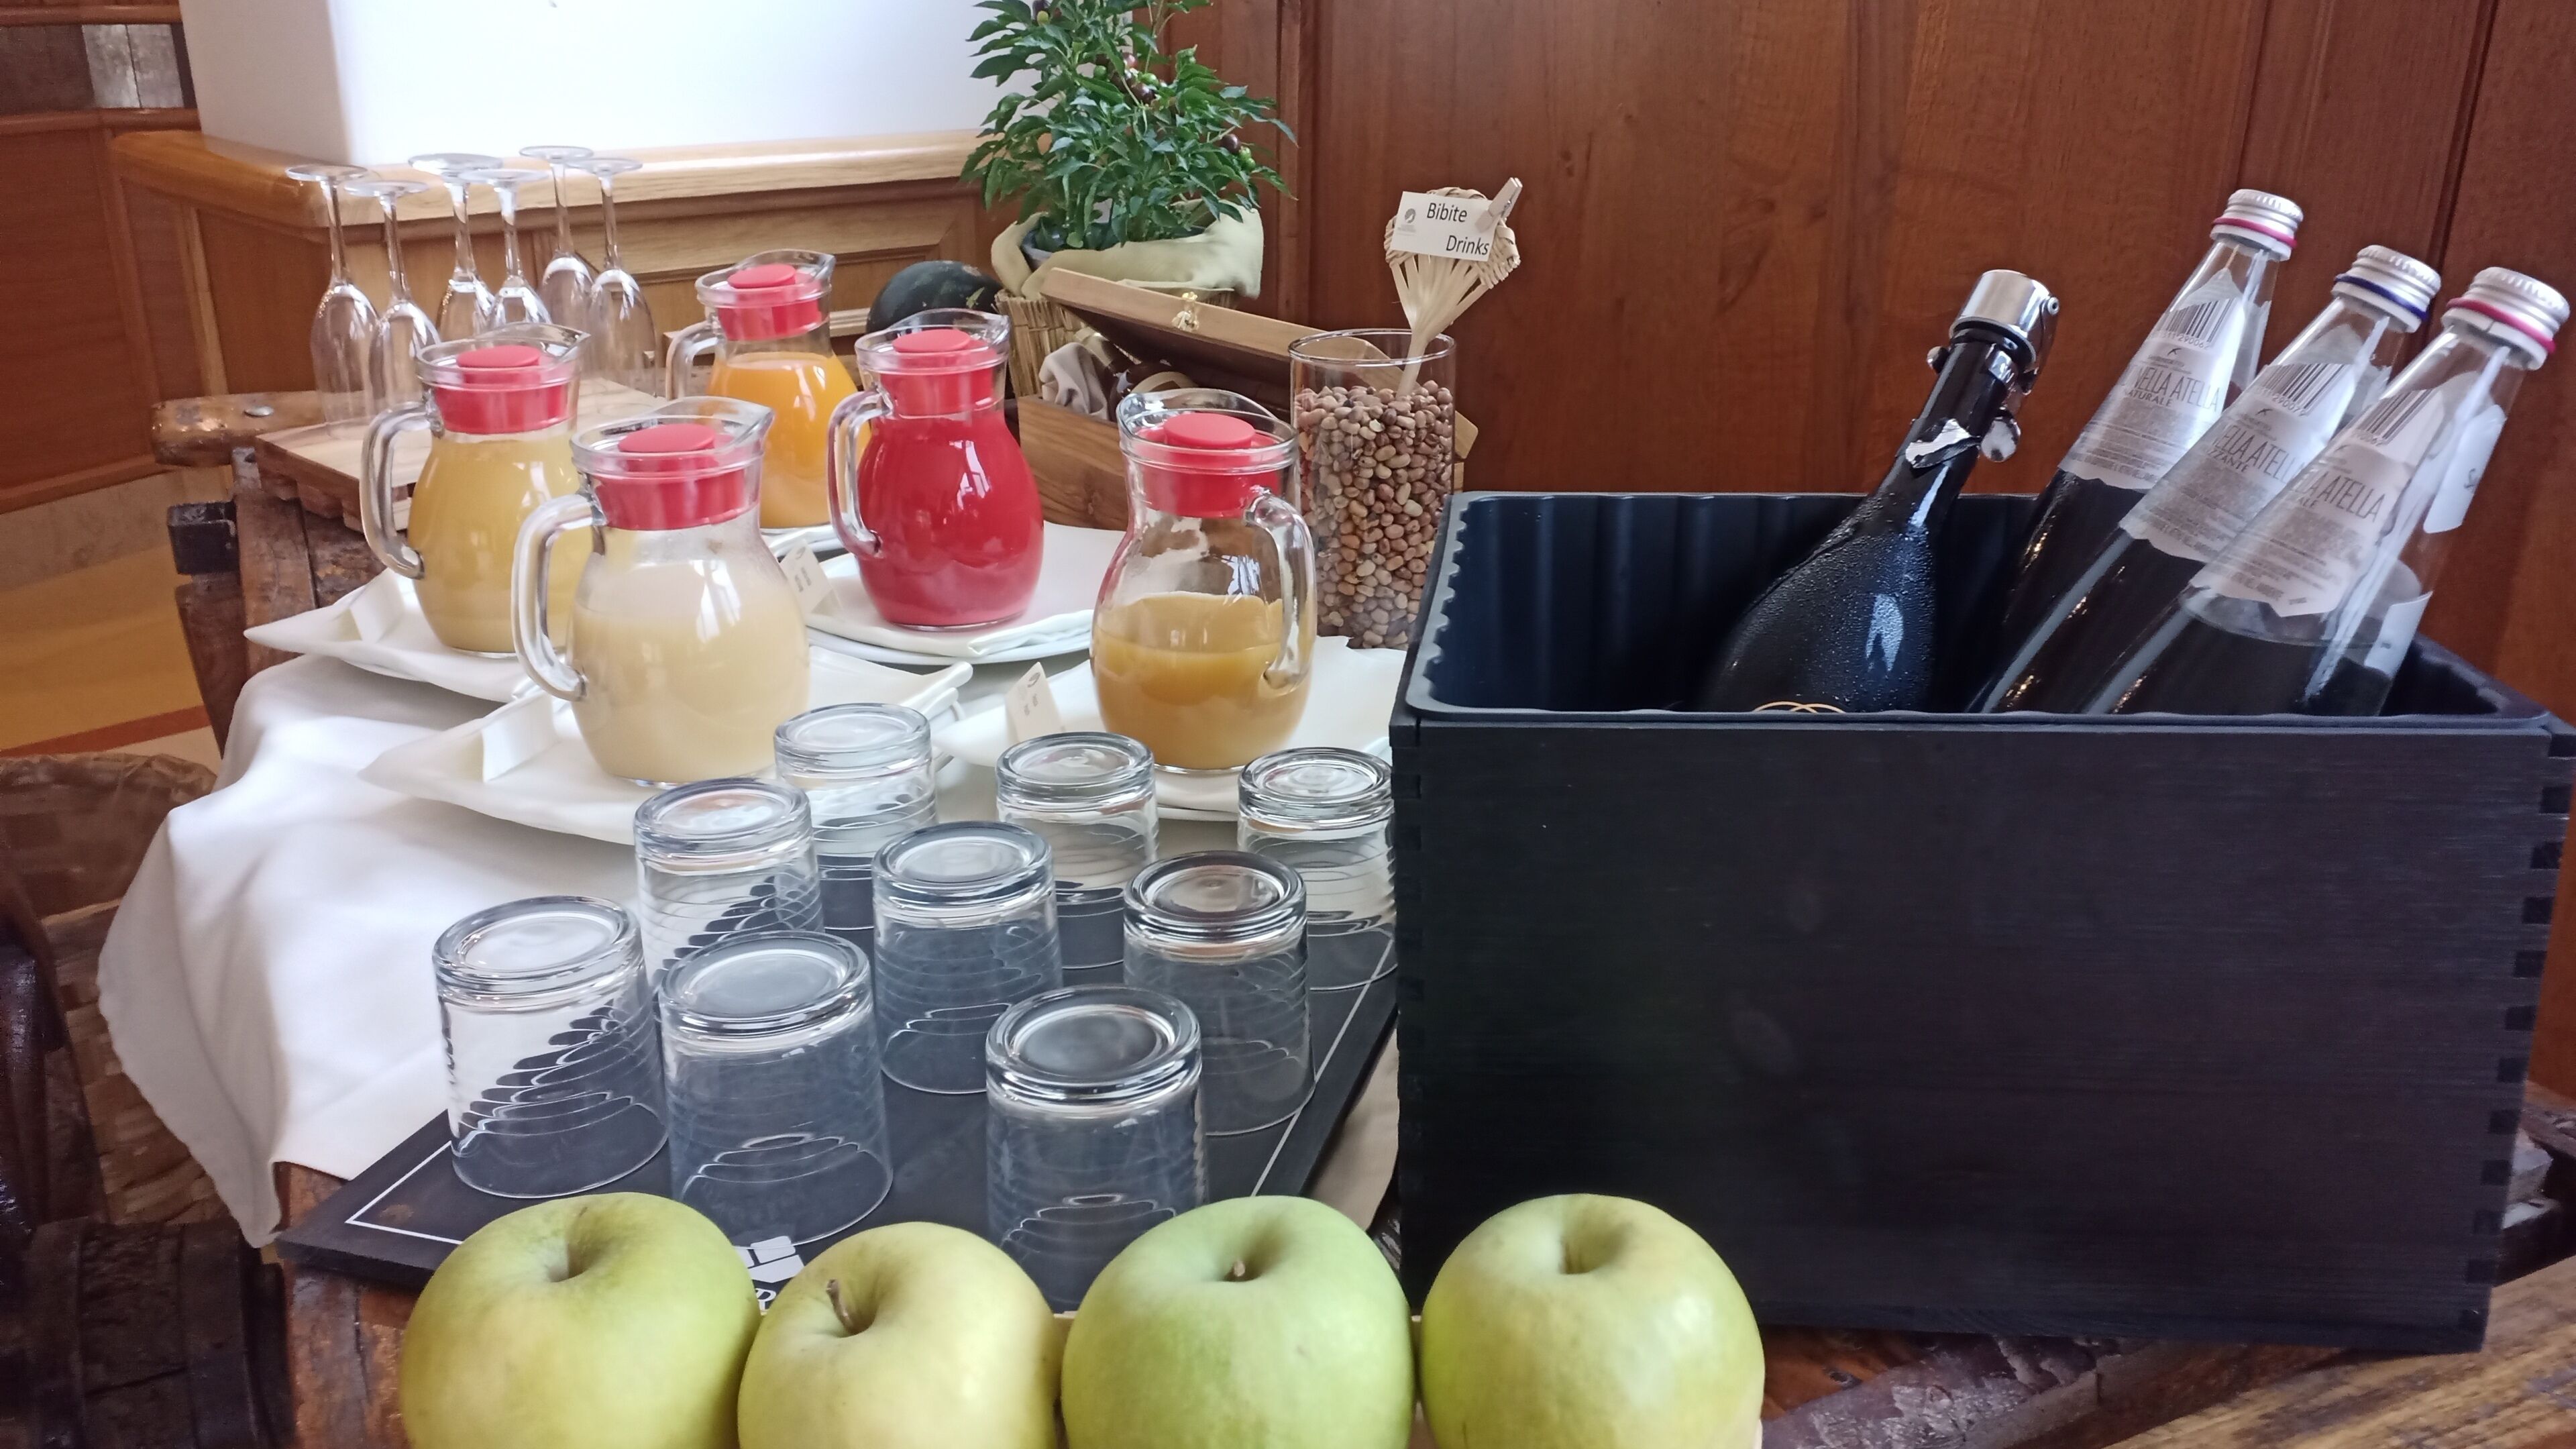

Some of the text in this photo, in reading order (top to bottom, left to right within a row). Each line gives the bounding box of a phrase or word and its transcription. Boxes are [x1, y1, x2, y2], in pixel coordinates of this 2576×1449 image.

[1427, 202, 1467, 223] Bibite
[1446, 235, 1489, 256] Drinks
[2316, 475, 2385, 523] ATELLA
